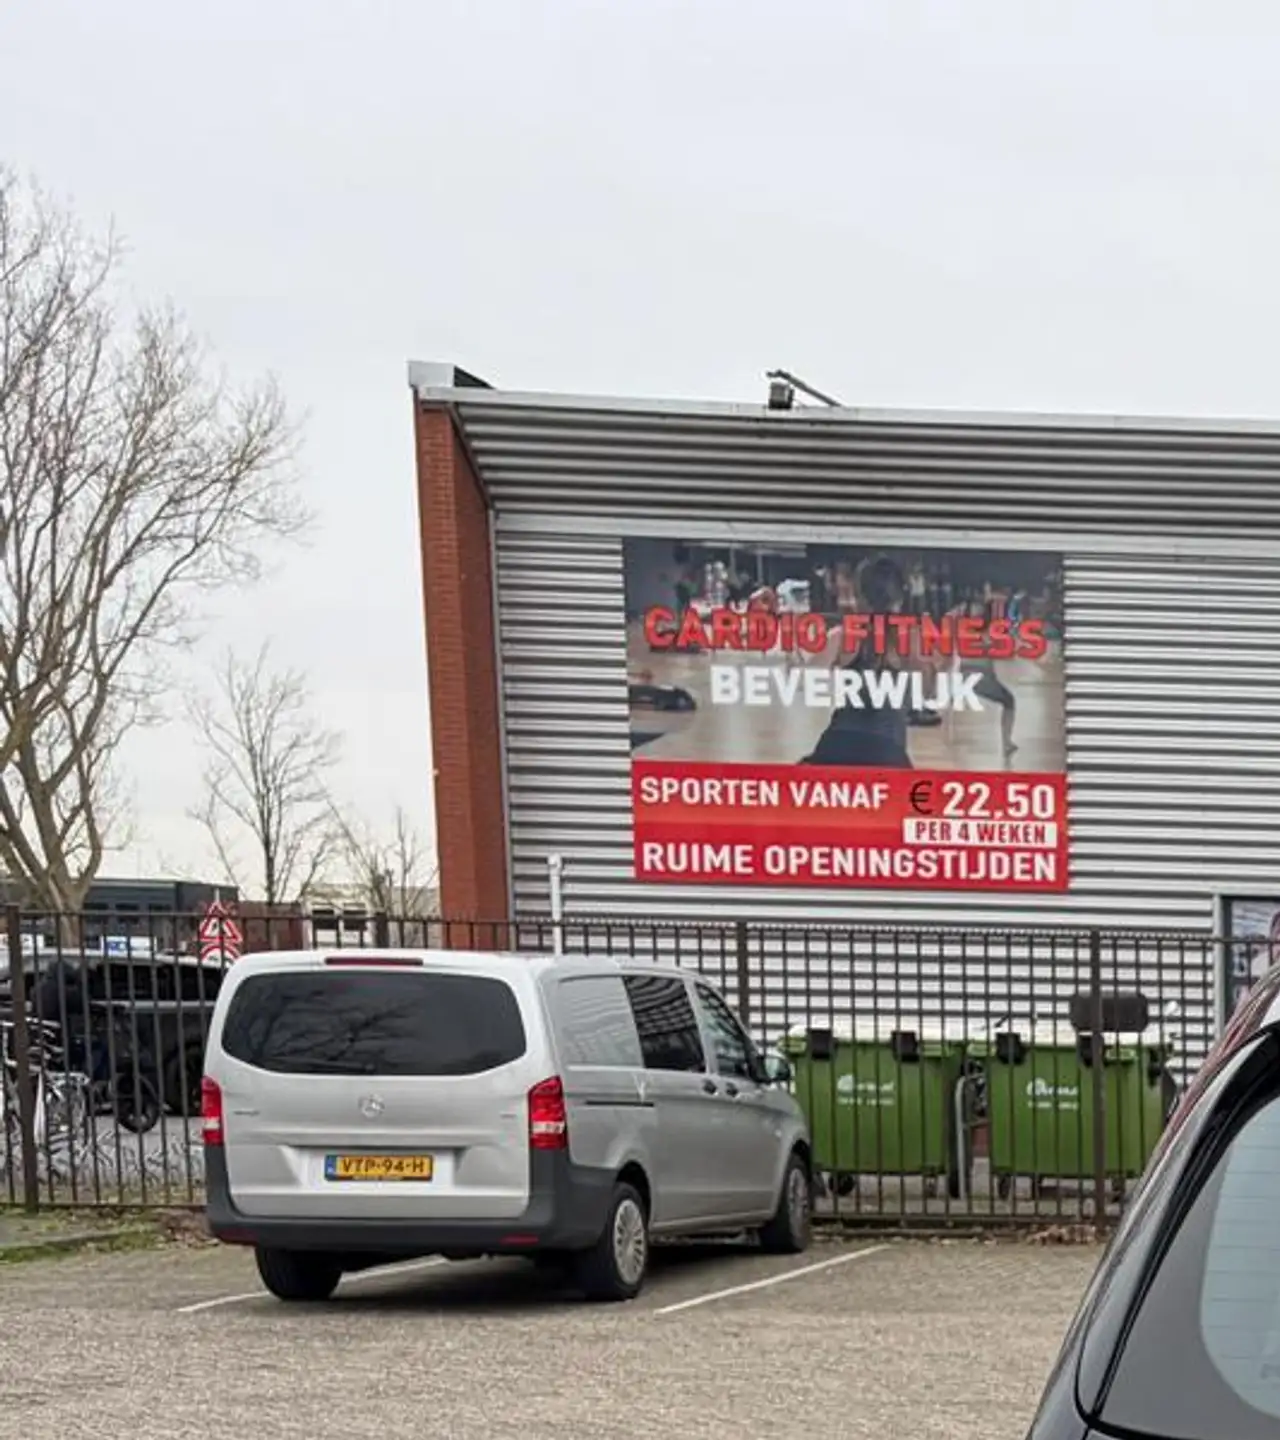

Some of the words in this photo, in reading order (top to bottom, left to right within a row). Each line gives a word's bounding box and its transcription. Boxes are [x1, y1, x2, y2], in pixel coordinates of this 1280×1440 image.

[643, 604, 829, 655] CARDIO
[842, 612, 1049, 660] FITNESS
[710, 665, 985, 712] BEVERWIJK
[640, 776, 779, 808] SPORTEN
[790, 781, 890, 811] VANAF
[909, 780, 933, 816] €
[914, 820, 954, 843] PER
[959, 822, 971, 843] 4
[978, 822, 1047, 845] WEKEN
[642, 842, 754, 874] RUIME
[764, 845, 1057, 882] OPENINGSTIJDEN
